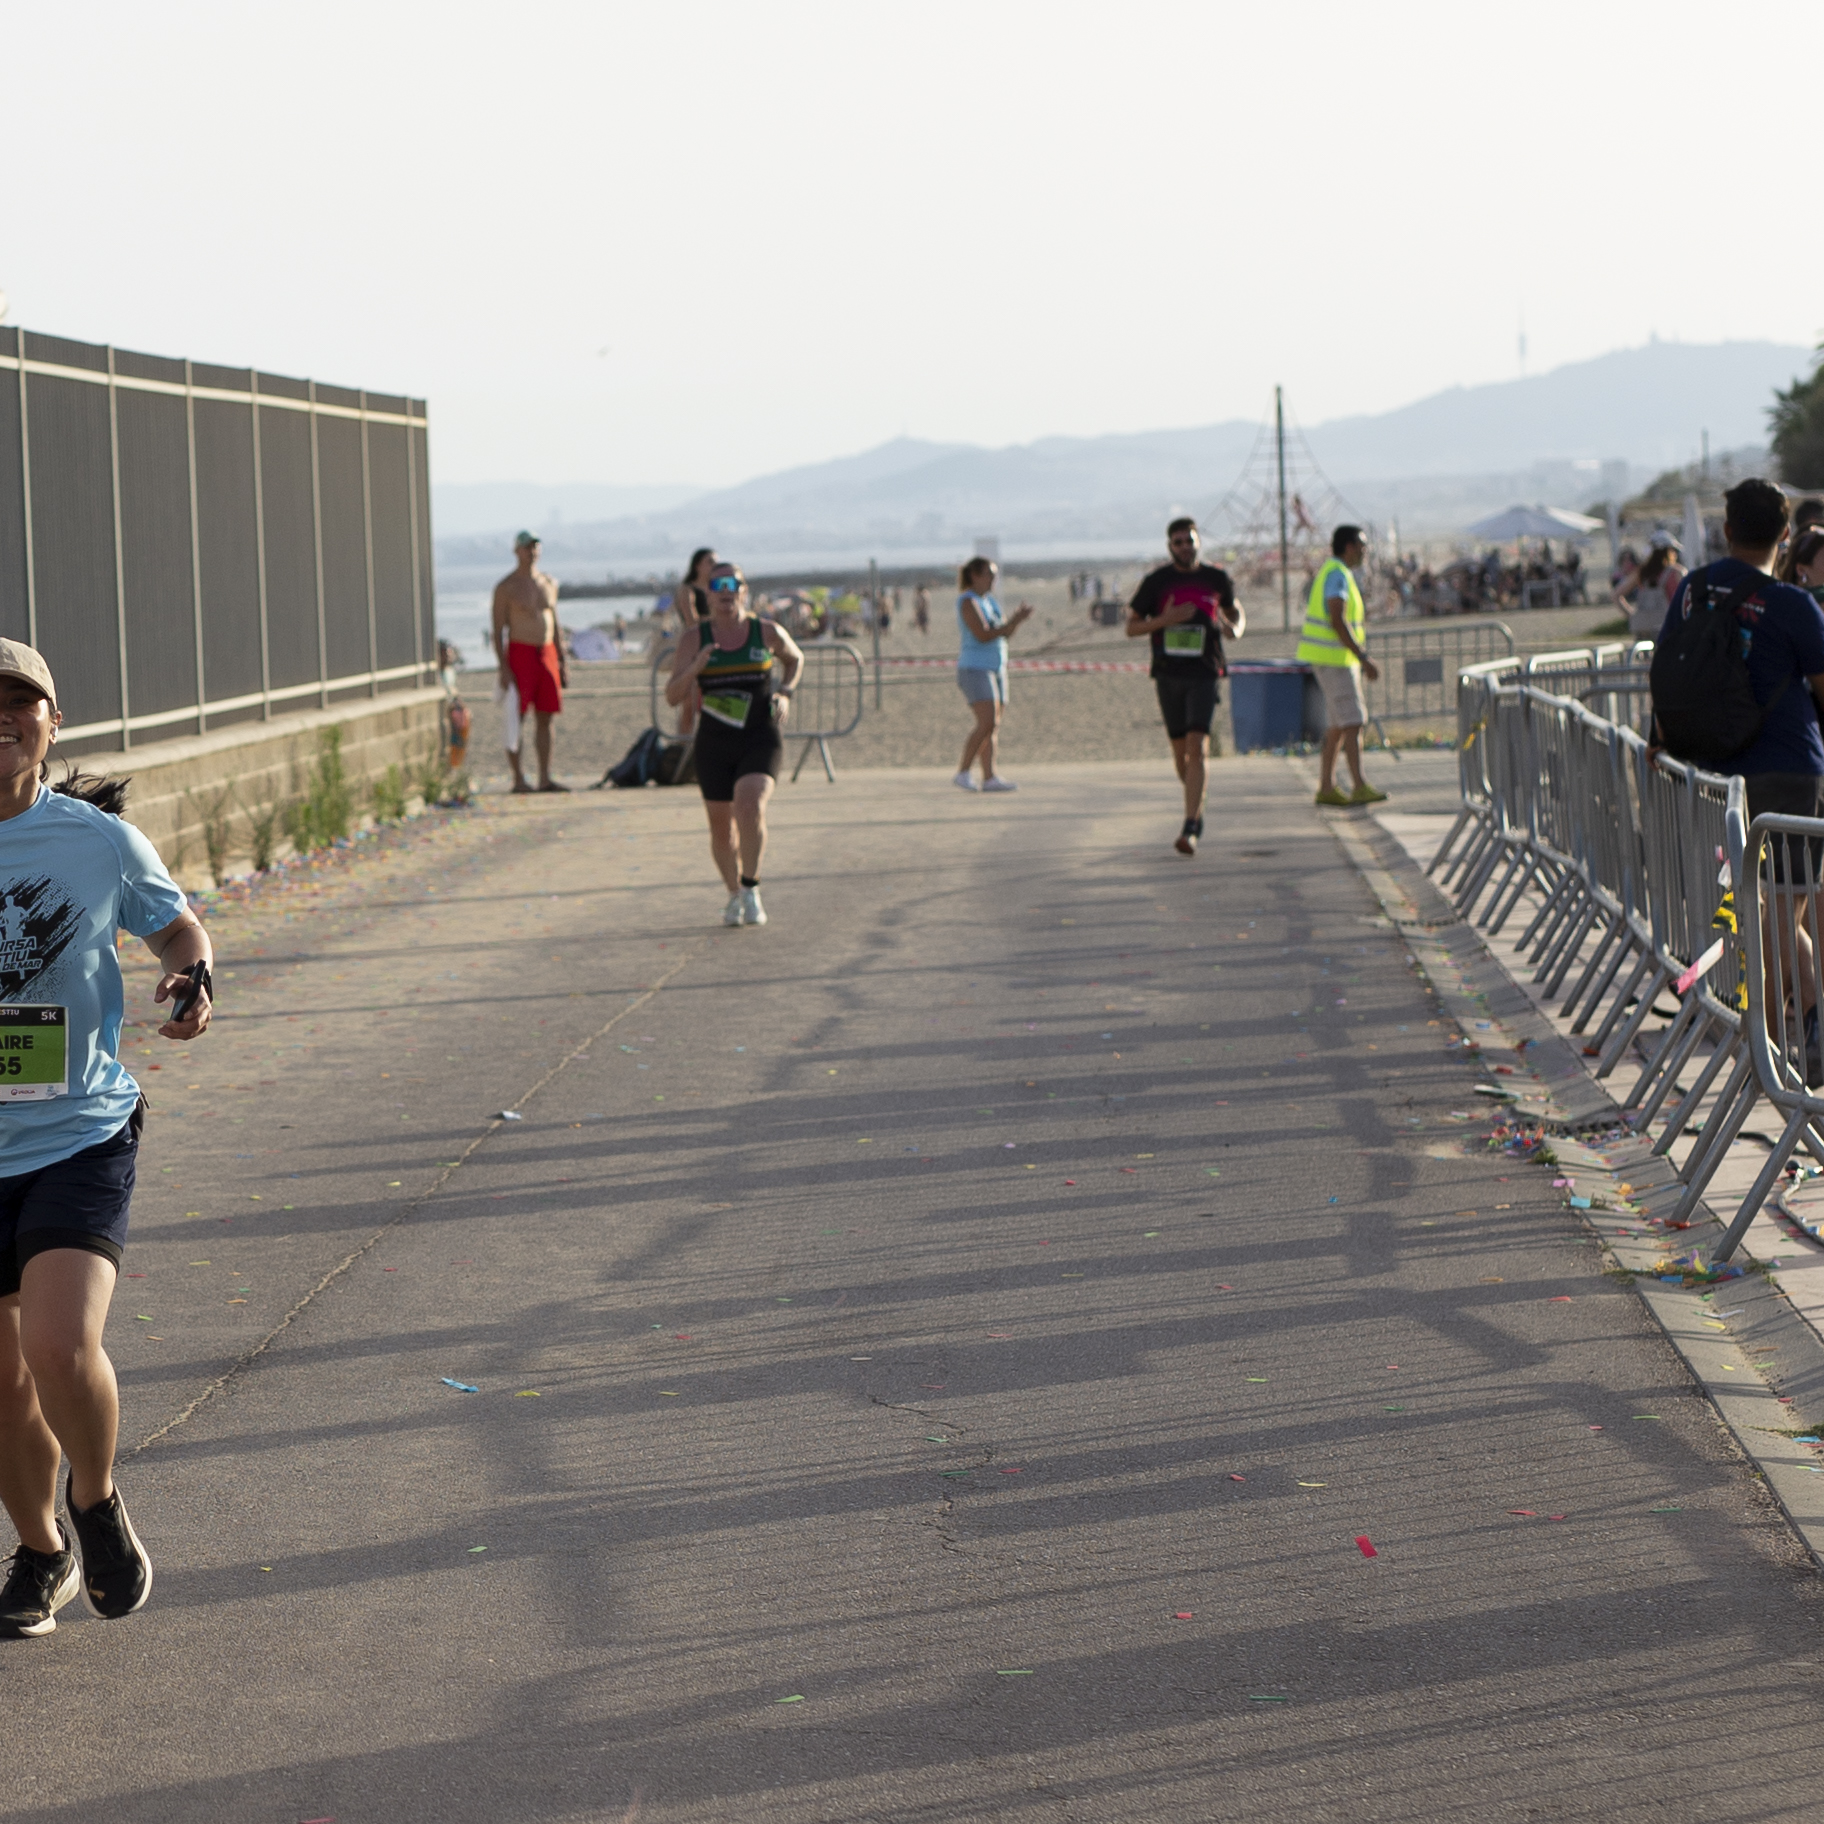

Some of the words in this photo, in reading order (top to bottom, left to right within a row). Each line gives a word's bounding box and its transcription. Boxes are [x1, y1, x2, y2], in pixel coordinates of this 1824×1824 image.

[3, 962, 16, 971] DE
[18, 960, 42, 969] MAR
[41, 1011, 57, 1021] 5K
